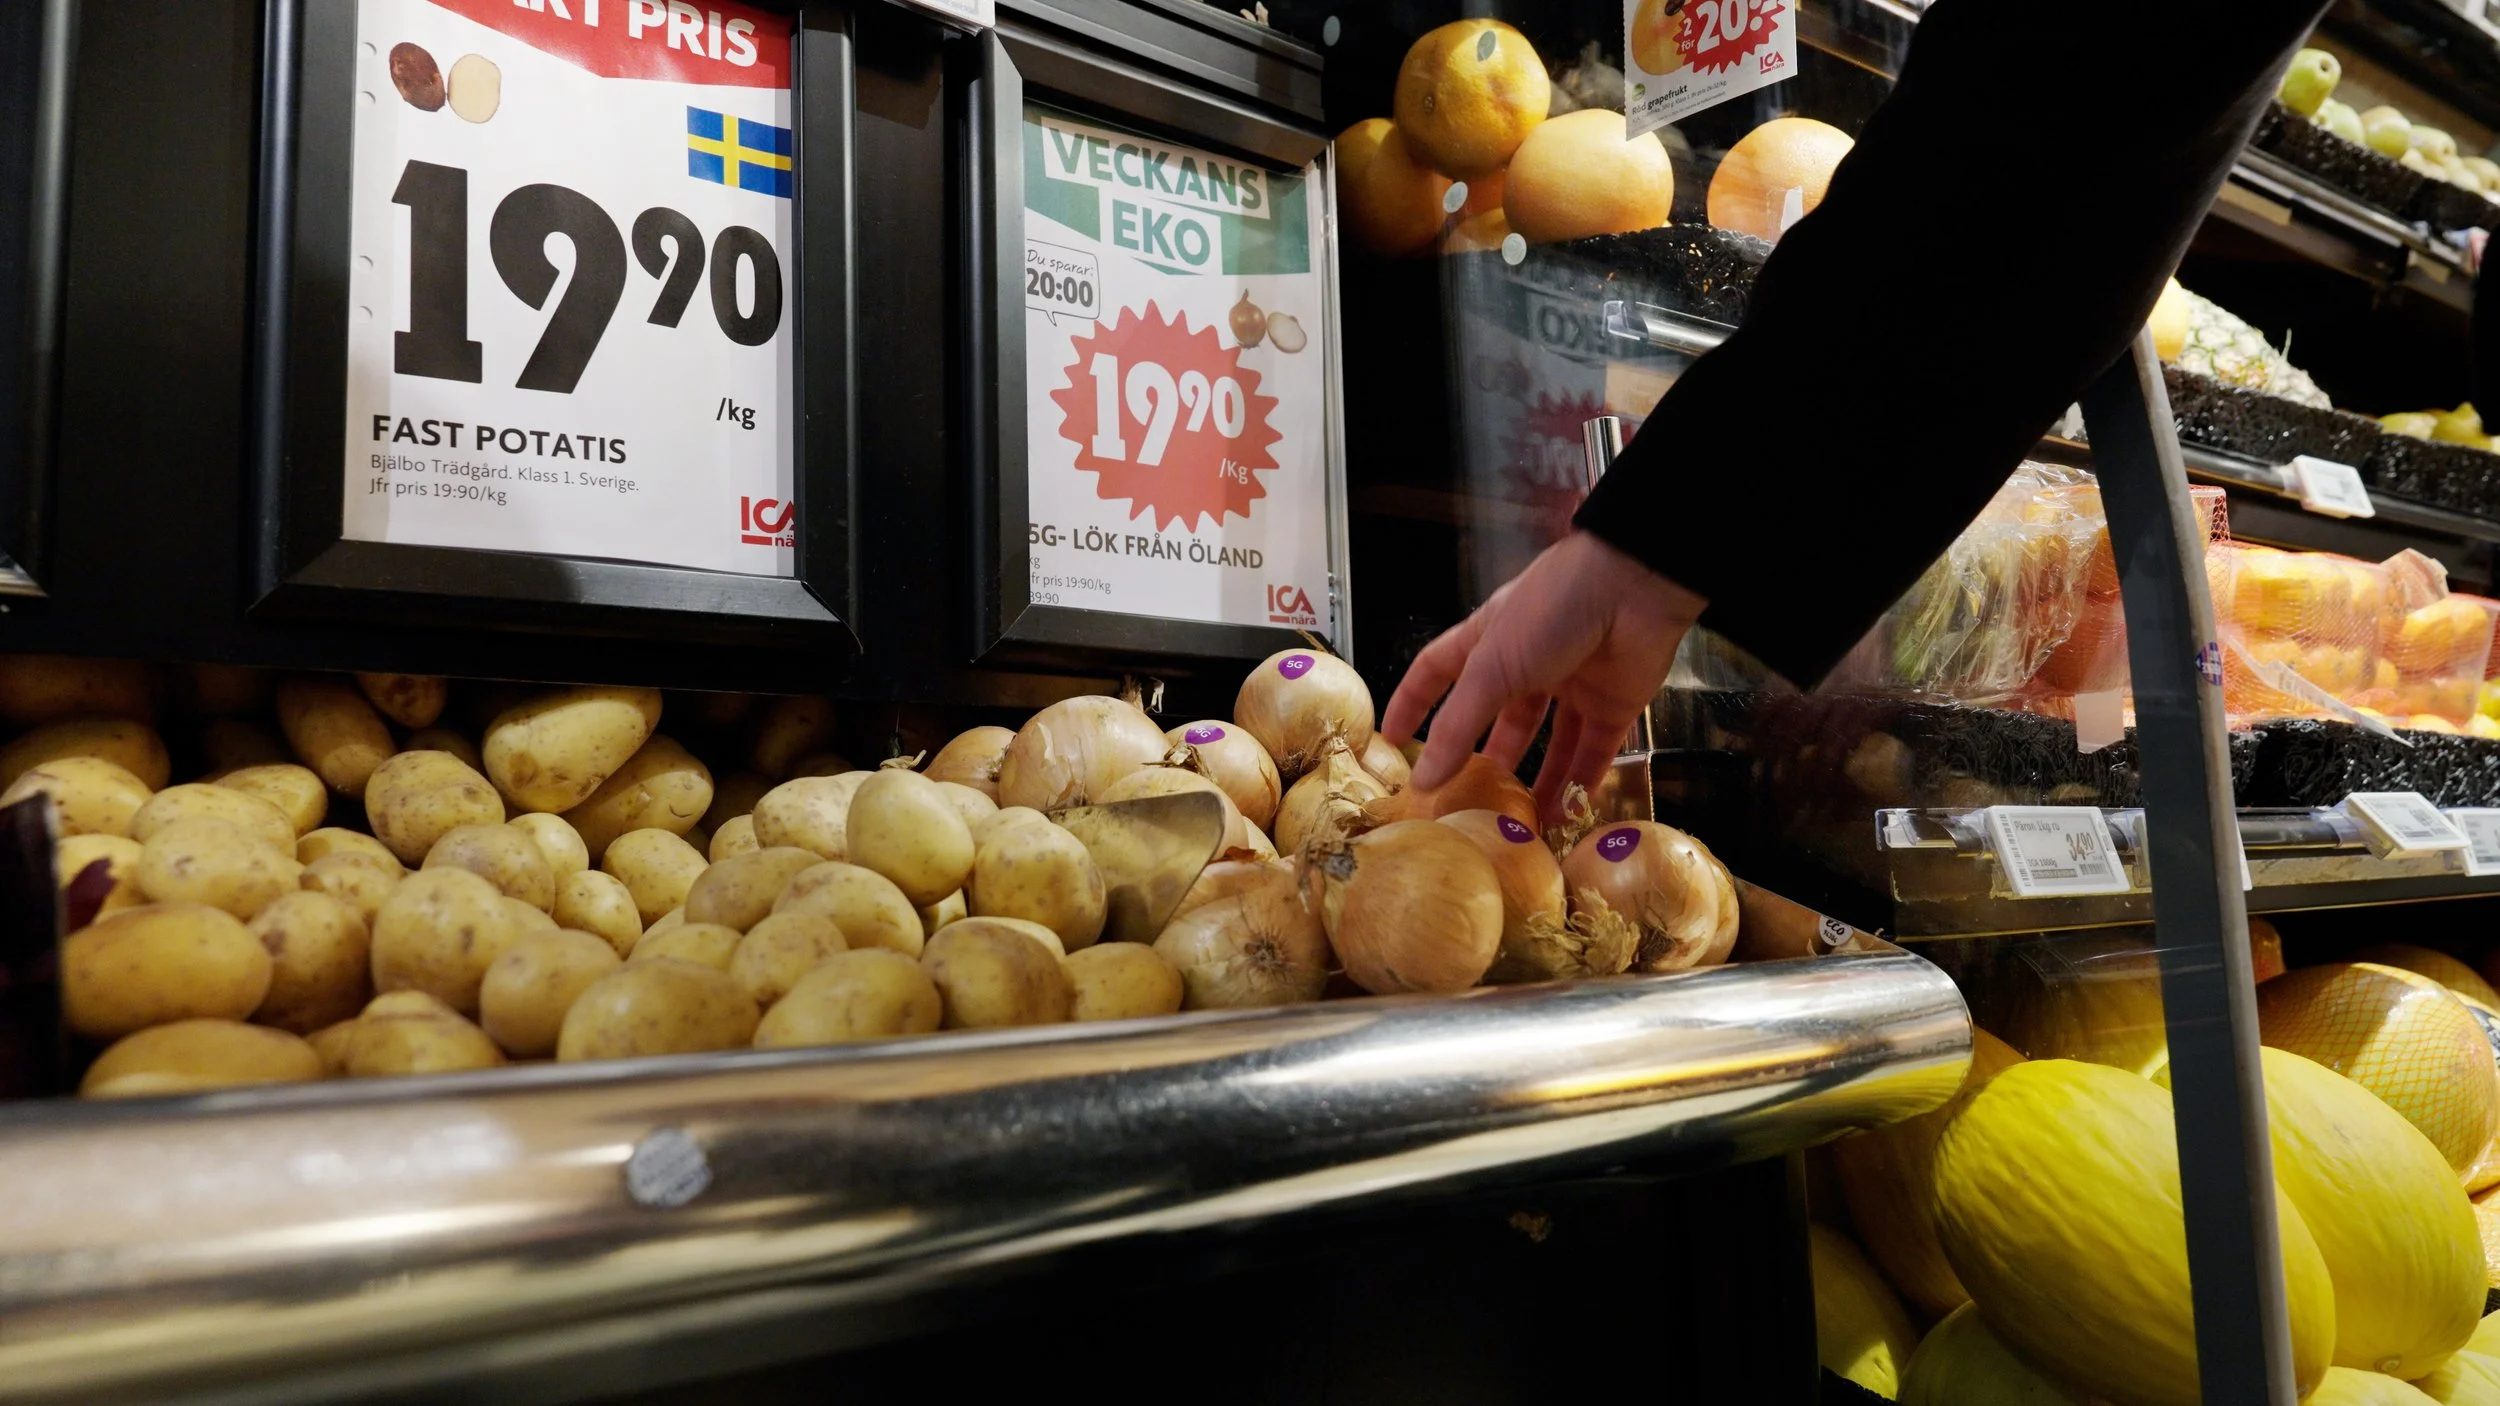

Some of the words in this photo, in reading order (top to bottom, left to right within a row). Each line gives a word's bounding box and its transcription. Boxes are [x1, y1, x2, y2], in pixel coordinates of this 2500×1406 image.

[628, 0, 758, 67] PRIS
[1683, 18, 1692, 37] 2
[1681, 40, 1695, 52] för
[1759, 51, 1784, 70] ICA
[1632, 101, 1646, 115] Röd
[1647, 85, 1688, 110] grapefrukt
[1048, 127, 1260, 210] VECKANS
[1112, 198, 1211, 266] EKO
[1026, 249, 1045, 264] Du
[1026, 267, 1094, 308] 20:00
[716, 397, 756, 430] /kg
[372, 414, 464, 449] FAST
[476, 425, 627, 464] POTATIS
[371, 454, 426, 474] Bjälbo
[432, 458, 512, 482] Trädgård.
[518, 467, 559, 484] Klass
[563, 471, 575, 485] 1.
[579, 472, 640, 493] Sverige.
[1219, 457, 1249, 485] /Kg
[369, 477, 390, 495] Jfr
[396, 479, 428, 498] pris
[433, 483, 507, 506] 19:90/kg
[1029, 522, 1067, 548] 5G-
[1073, 526, 1118, 555] LÖK
[1125, 532, 1182, 561] FRÅN
[1188, 539, 1263, 569] ÖLAND
[1031, 571, 1041, 584] fr
[1043, 575, 1063, 588] pris
[1066, 576, 1112, 595] 19:90/kg
[1267, 583, 1315, 616] ICA
[1290, 615, 1317, 626] nära
[1286, 660, 1303, 669] 5G
[1195, 727, 1211, 738] 5G
[1606, 836, 1628, 848] 5G
[1826, 919, 1845, 936] eco
